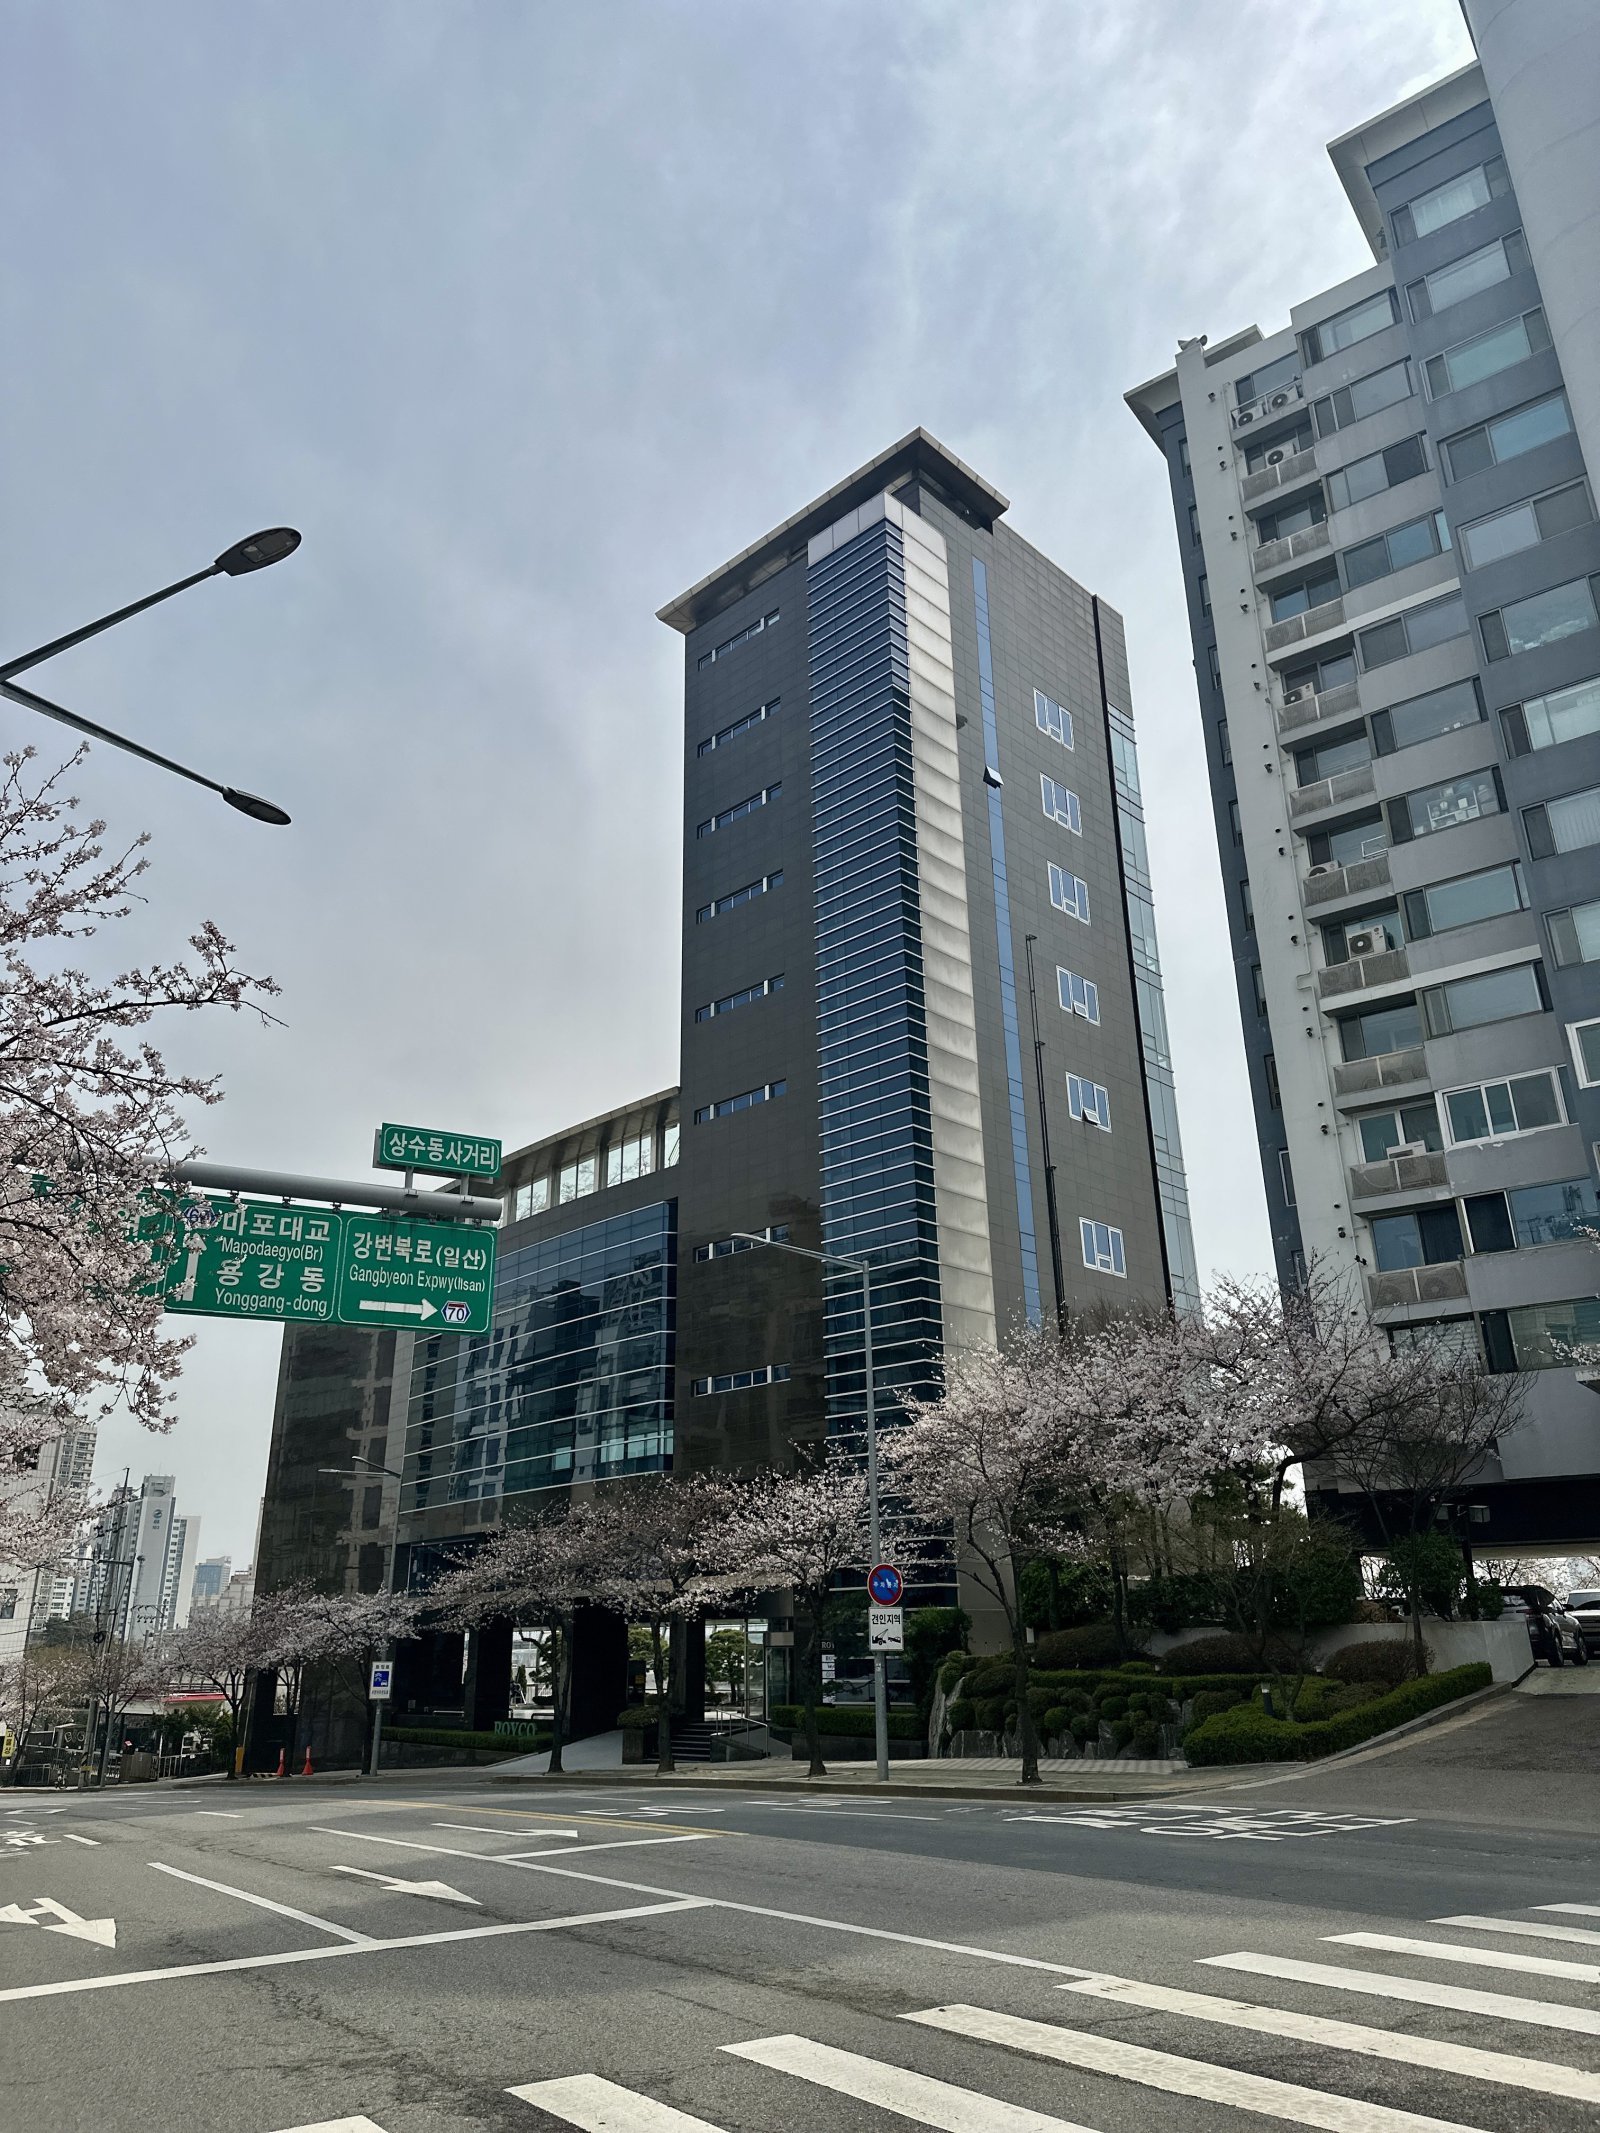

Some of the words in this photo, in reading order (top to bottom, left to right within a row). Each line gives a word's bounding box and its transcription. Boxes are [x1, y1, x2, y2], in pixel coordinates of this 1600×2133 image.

[388, 1132, 495, 1170] 상수동사거리
[222, 1211, 330, 1242] 마포대교
[221, 1238, 324, 1263] Mapodaegyo(Br)
[353, 1231, 487, 1271] 강변북로(일산)
[216, 1259, 326, 1293] 용강동
[349, 1264, 414, 1288] Gangbyeon
[417, 1273, 486, 1294] Expwy(Ilsan)
[214, 1287, 328, 1317] Yonggang-dong
[446, 1305, 466, 1322] 70
[871, 1614, 901, 1625] 견인지역
[494, 1721, 537, 1736] ROYCO
